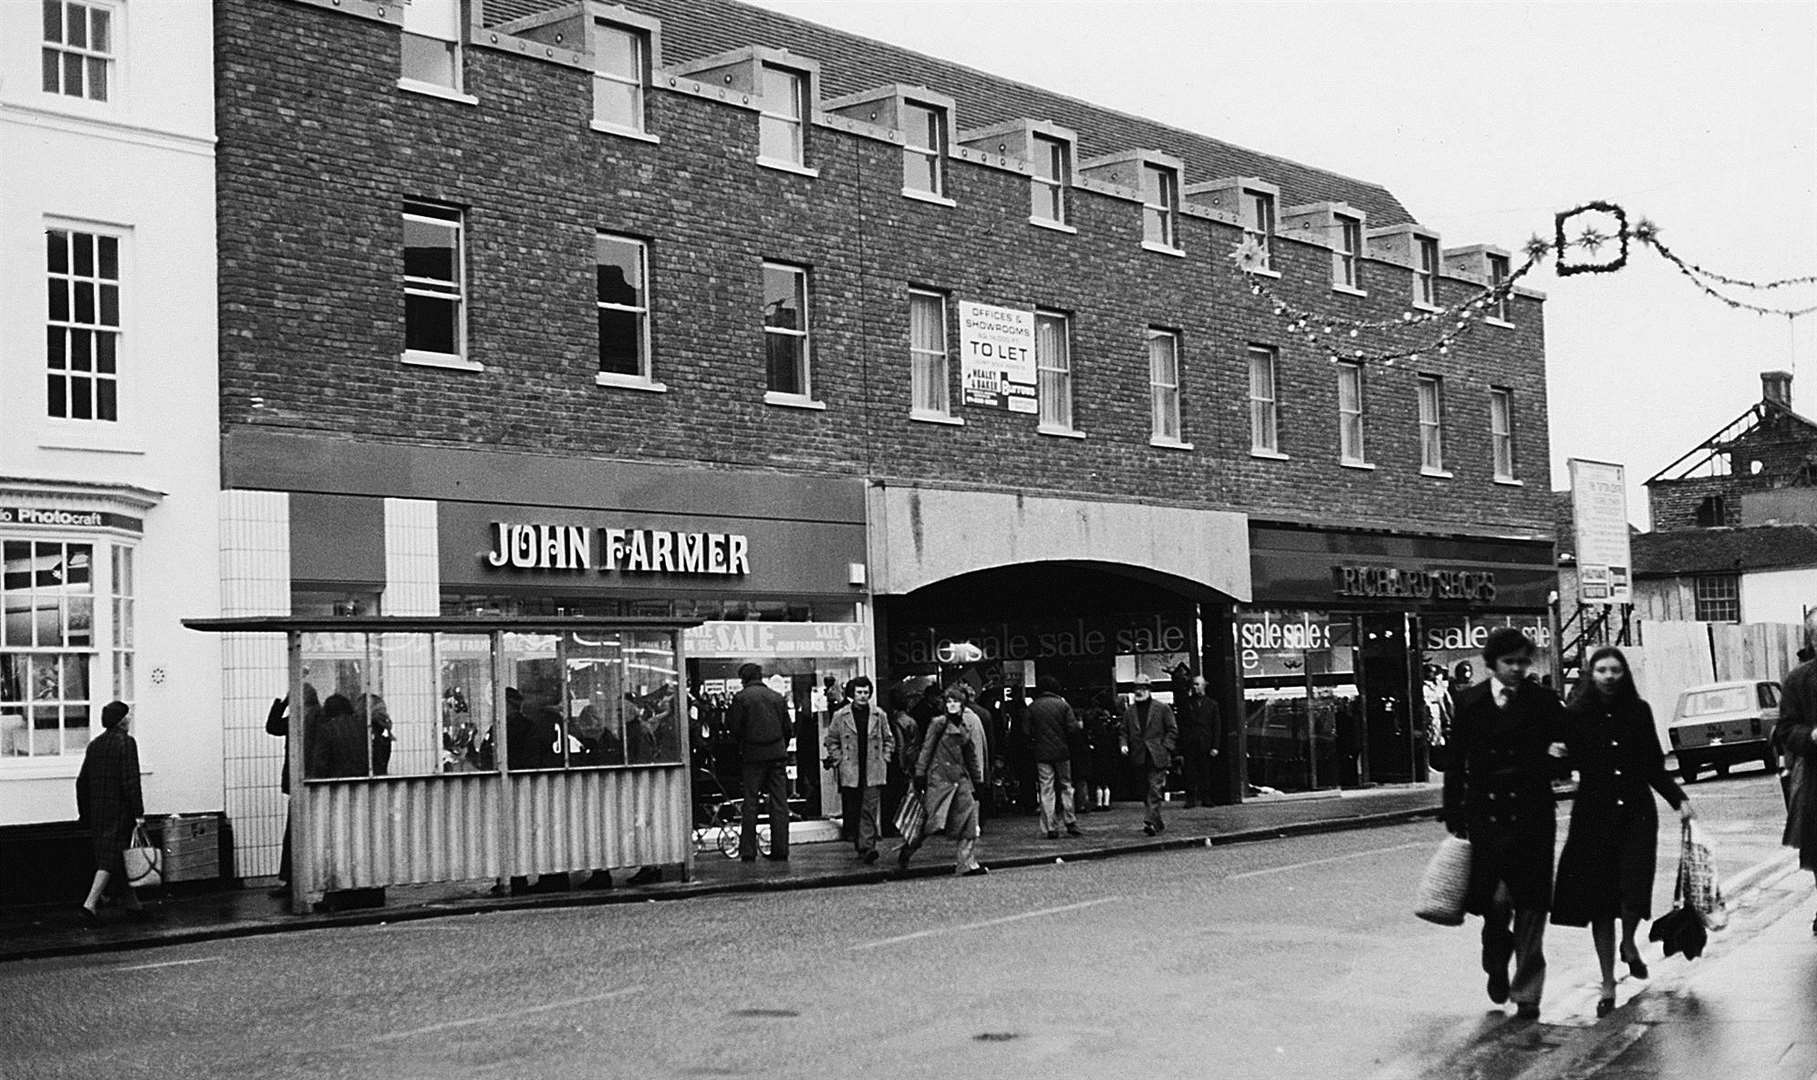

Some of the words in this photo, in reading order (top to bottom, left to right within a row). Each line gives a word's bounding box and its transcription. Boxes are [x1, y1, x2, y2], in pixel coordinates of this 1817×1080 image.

[966, 319, 1030, 337] SHOWROOMS
[972, 308, 1012, 322] OFFICES
[970, 340, 993, 357] TO
[998, 345, 1028, 362] LET
[18, 508, 101, 525] Photocraft
[487, 523, 591, 569] JOHN
[605, 528, 751, 574] FARMER
[1341, 566, 1433, 598] RICHARD
[1437, 569, 1497, 601] SHOPS
[716, 624, 775, 652] SALE
[896, 627, 951, 664] sale
[1038, 619, 1105, 657] sale
[1115, 614, 1185, 653] sale
[1241, 611, 1282, 648] sale
[1283, 611, 1321, 648] sale
[1427, 616, 1489, 650] sale
